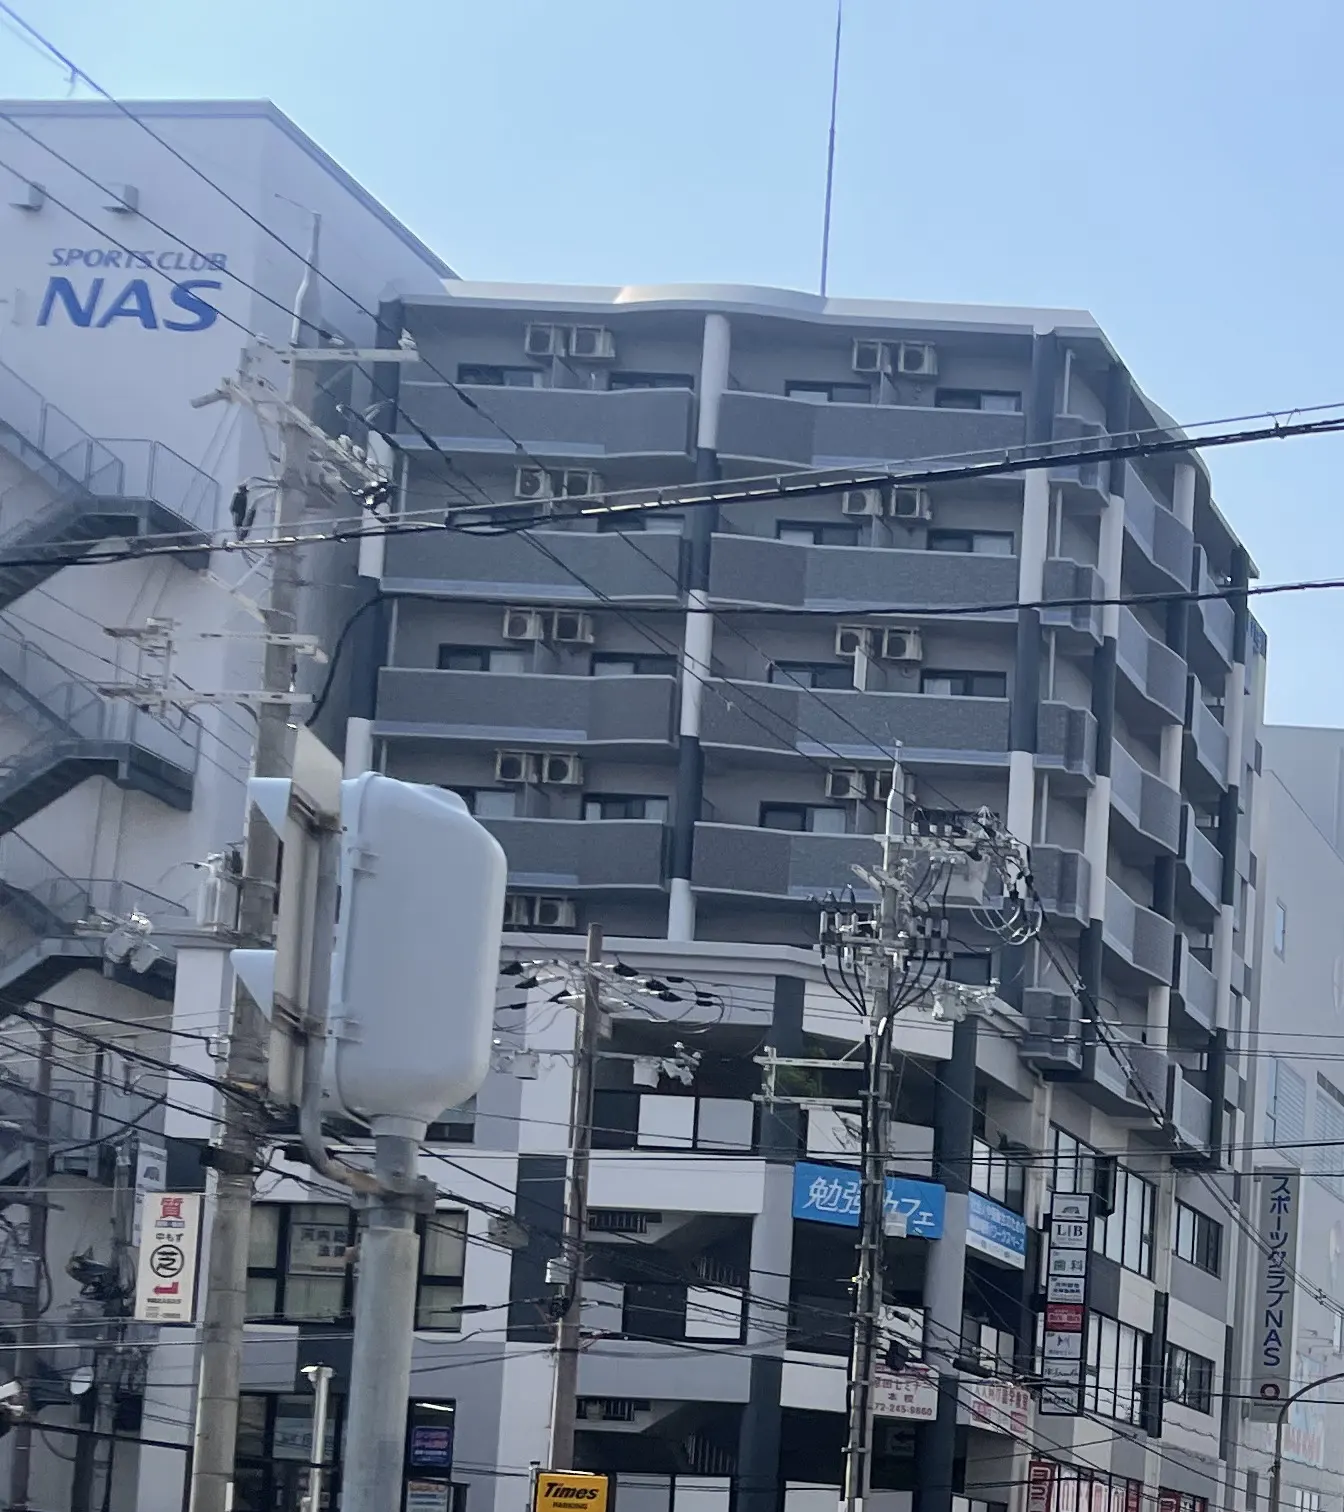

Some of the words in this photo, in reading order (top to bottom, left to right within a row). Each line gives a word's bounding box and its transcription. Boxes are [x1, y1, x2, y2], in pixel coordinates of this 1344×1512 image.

[47, 248, 154, 270] SPORTS
[156, 251, 228, 271] CLUB
[36, 276, 222, 332] NAS
[160, 1197, 184, 1219] 質
[544, 1482, 599, 1500] Times
